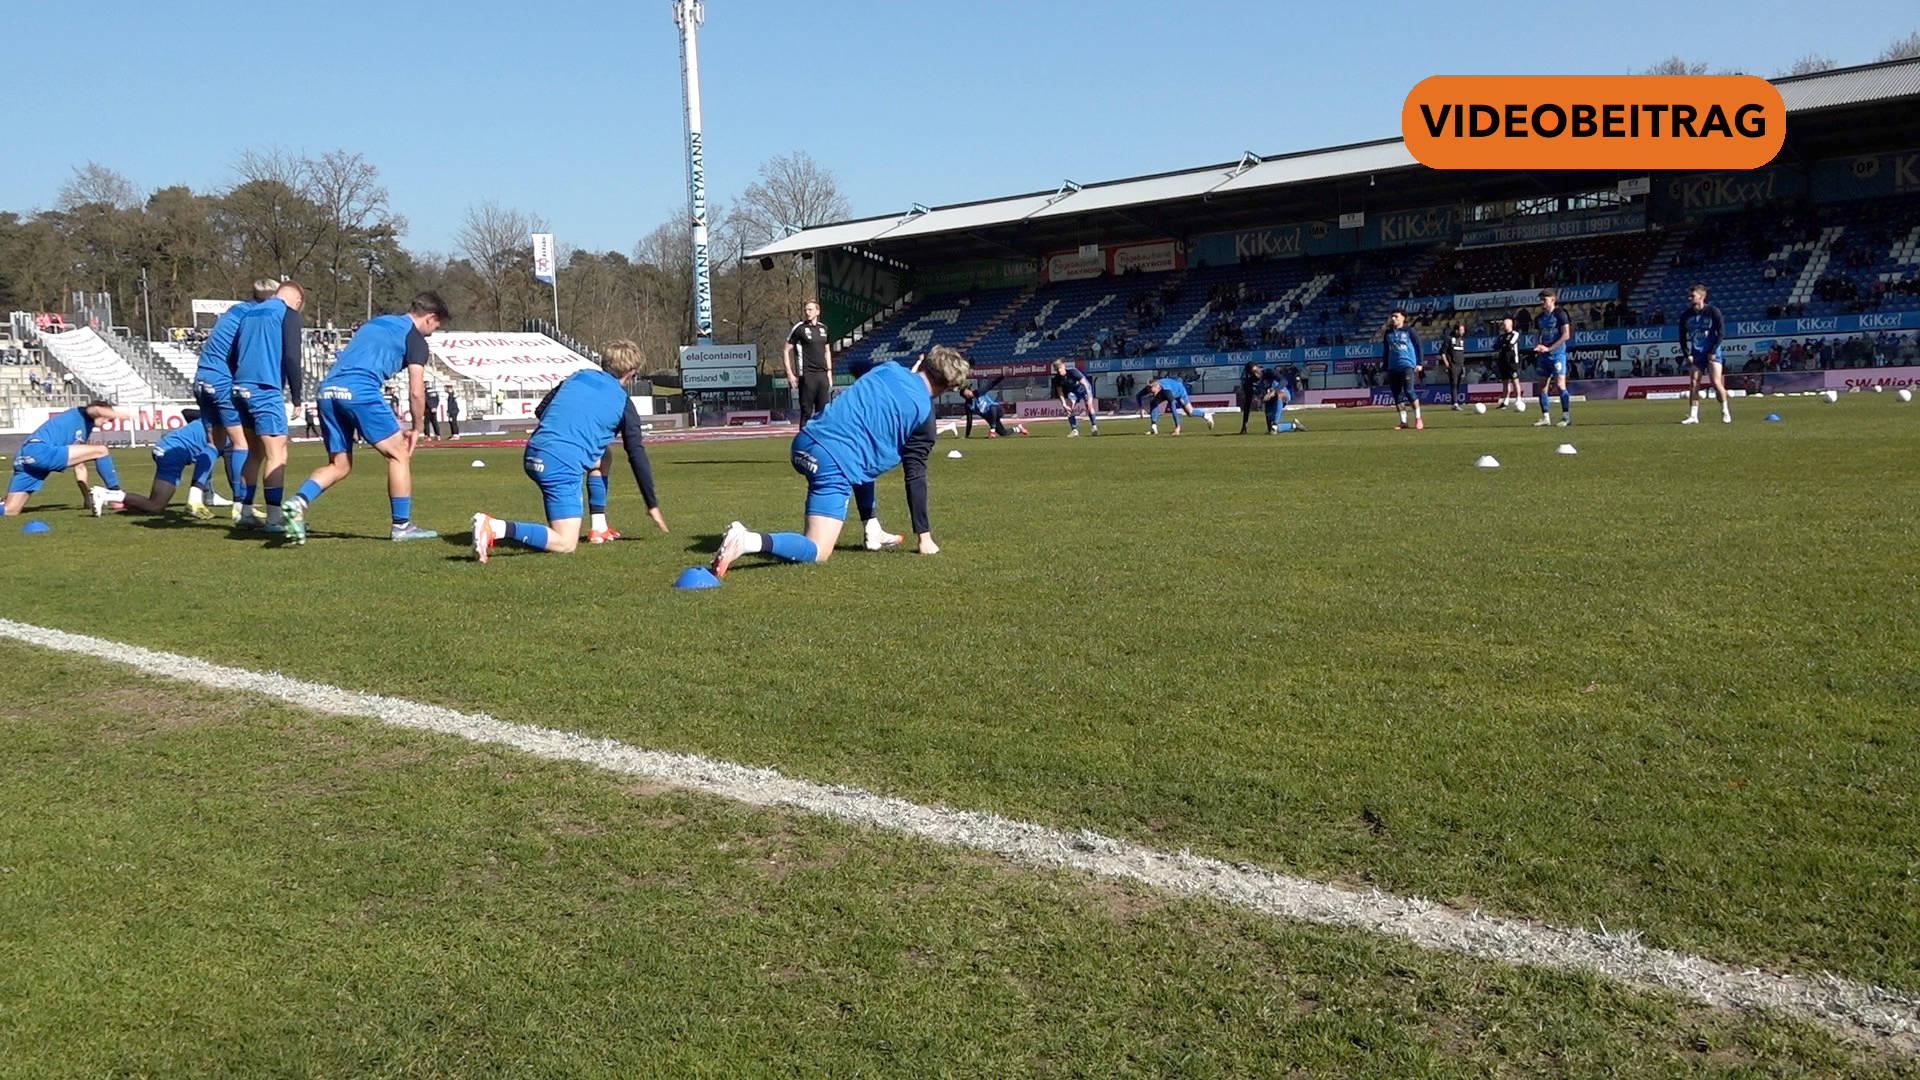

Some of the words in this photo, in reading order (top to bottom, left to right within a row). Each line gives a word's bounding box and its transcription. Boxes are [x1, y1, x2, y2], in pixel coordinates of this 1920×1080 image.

[1494, 222, 1557, 242] TREFFSICHER
[1558, 219, 1581, 235] SEIT
[1585, 216, 1611, 233] 1999
[1234, 227, 1301, 262] KiKxxl
[1737, 320, 1777, 335] KiKxxl
[1796, 316, 1838, 332] KiKxxl
[1859, 313, 1903, 328] KiKxxl
[1574, 330, 1609, 343] KiKxxl
[1626, 327, 1663, 341] KiKxxl
[685, 350, 752, 362] ela[container]
[1264, 349, 1292, 361] KiKxxl
[1304, 347, 1332, 359] KiKxxl
[1344, 344, 1374, 357] KiKxxl
[446, 352, 580, 368] ExxonMobil
[683, 374, 718, 384] Emsland
